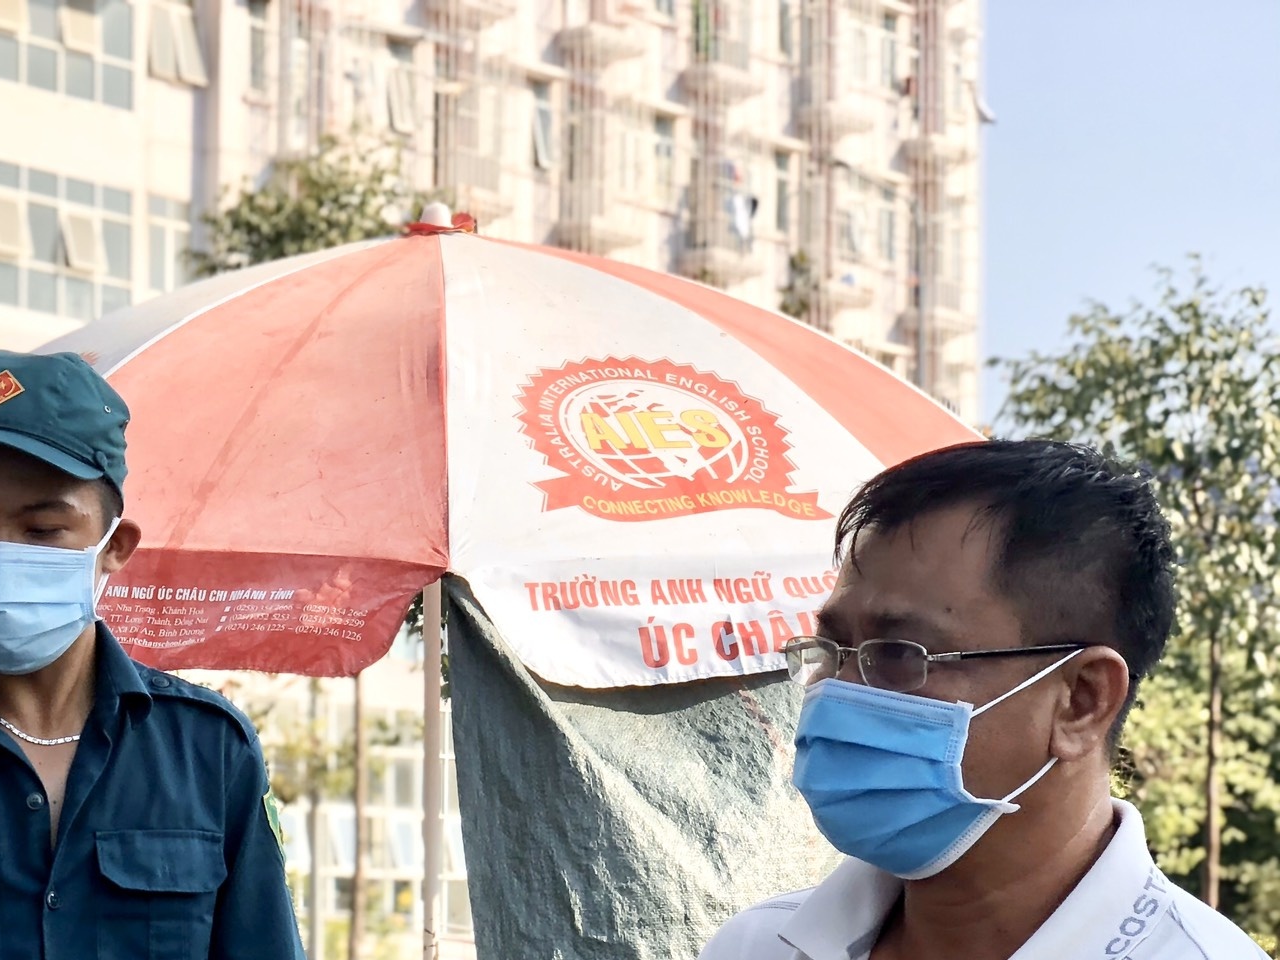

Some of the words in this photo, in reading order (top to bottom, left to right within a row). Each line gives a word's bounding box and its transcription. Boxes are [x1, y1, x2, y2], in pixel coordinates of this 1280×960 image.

[539, 367, 658, 412] INTERNATIONAL
[665, 373, 752, 422] ENGLISH
[579, 409, 731, 450] AIES
[539, 413, 623, 492] AUSTRALIA
[744, 425, 769, 484] SCHOOL
[582, 494, 697, 516] CONNECTING
[698, 489, 817, 517] KNOWLEDGE
[105, 585, 130, 598] ANH
[131, 585, 156, 600] NGỮ
[157, 585, 174, 601] ÚC
[175, 587, 207, 602] CHÂU
[208, 589, 227, 602] CHI
[229, 588, 267, 601] NHÁNH
[524, 574, 640, 612] TRƯỜNG
[651, 578, 706, 605] ANH
[713, 570, 775, 604] NGỮ
[782, 567, 839, 599] QUỐ
[294, 625, 322, 635] (0274)
[323, 627, 340, 637] 246
[341, 629, 363, 642] 1226
[637, 616, 700, 669] ÚC
